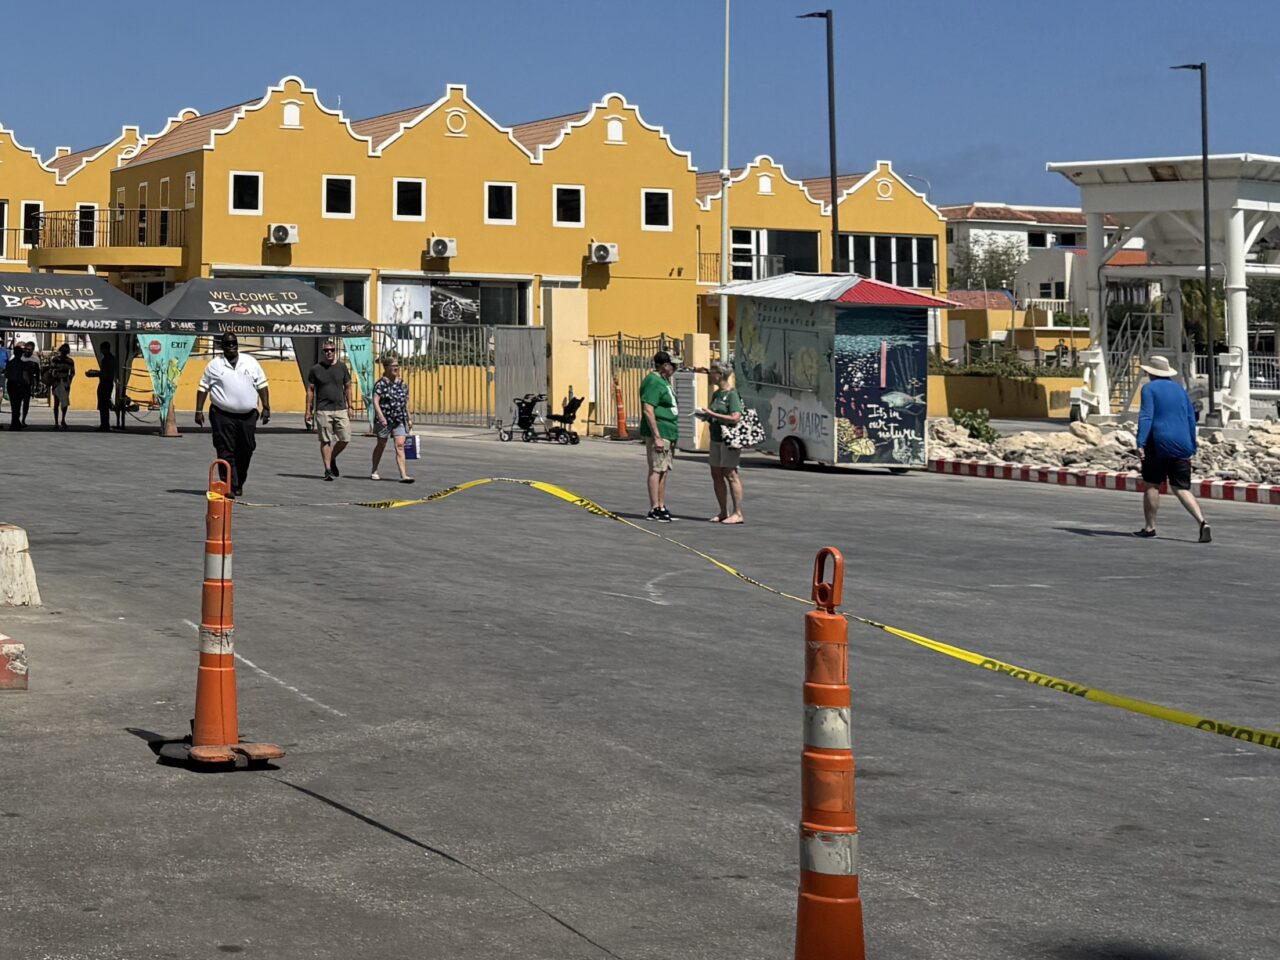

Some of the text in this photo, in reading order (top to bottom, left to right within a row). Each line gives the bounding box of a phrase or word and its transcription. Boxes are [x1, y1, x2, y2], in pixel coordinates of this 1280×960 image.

[3, 284, 94, 297] WELCOME TO
[209, 290, 298, 301] WELCOME TO
[1, 294, 109, 311] BONAIRE
[208, 301, 313, 316] BONAIRE
[10, 316, 118, 330] Welcome to PARADISE
[218, 321, 323, 333] Welcome to PARADISE
[171, 341, 188, 349] EXIT
[350, 344, 366, 352] EXIT
[889, 409, 903, 420] in
[777, 406, 829, 438] BONAIRE
[868, 419, 888, 431] our
[877, 422, 923, 440] nature
